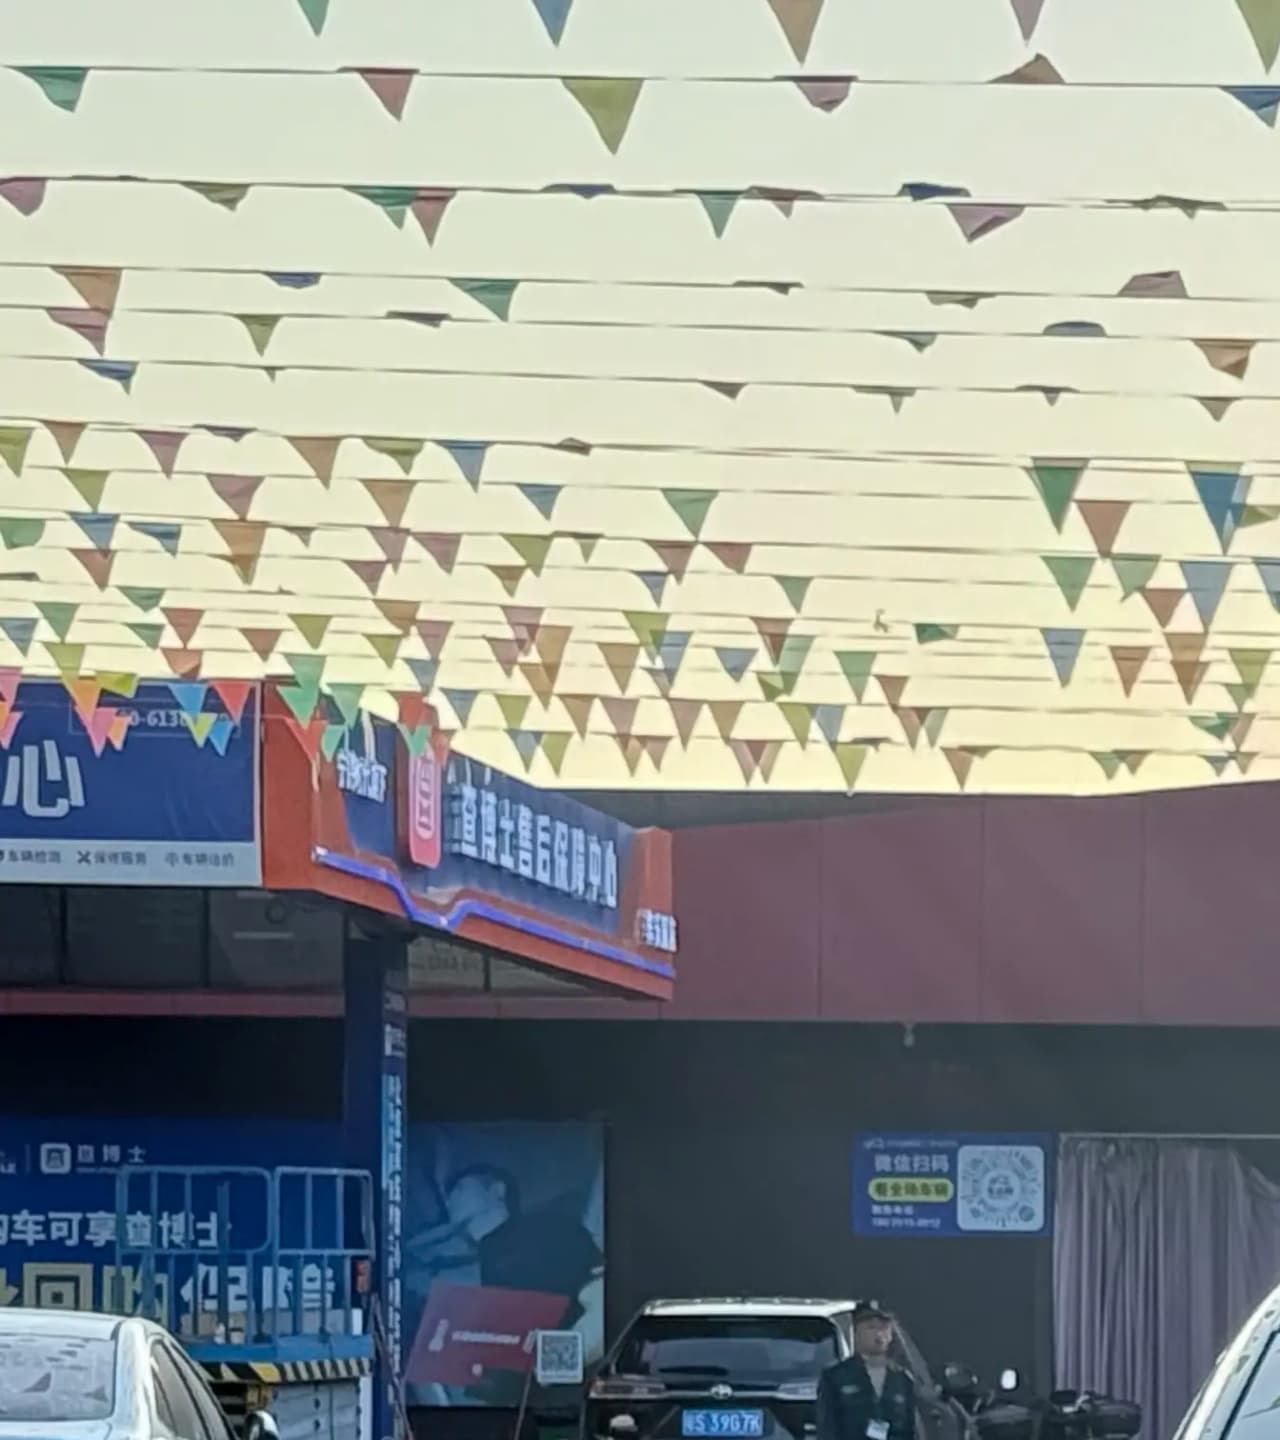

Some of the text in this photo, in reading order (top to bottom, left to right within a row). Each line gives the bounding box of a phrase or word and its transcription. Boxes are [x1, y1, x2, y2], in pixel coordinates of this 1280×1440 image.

[0, 1209, 222, 1248] 车可享查博士
